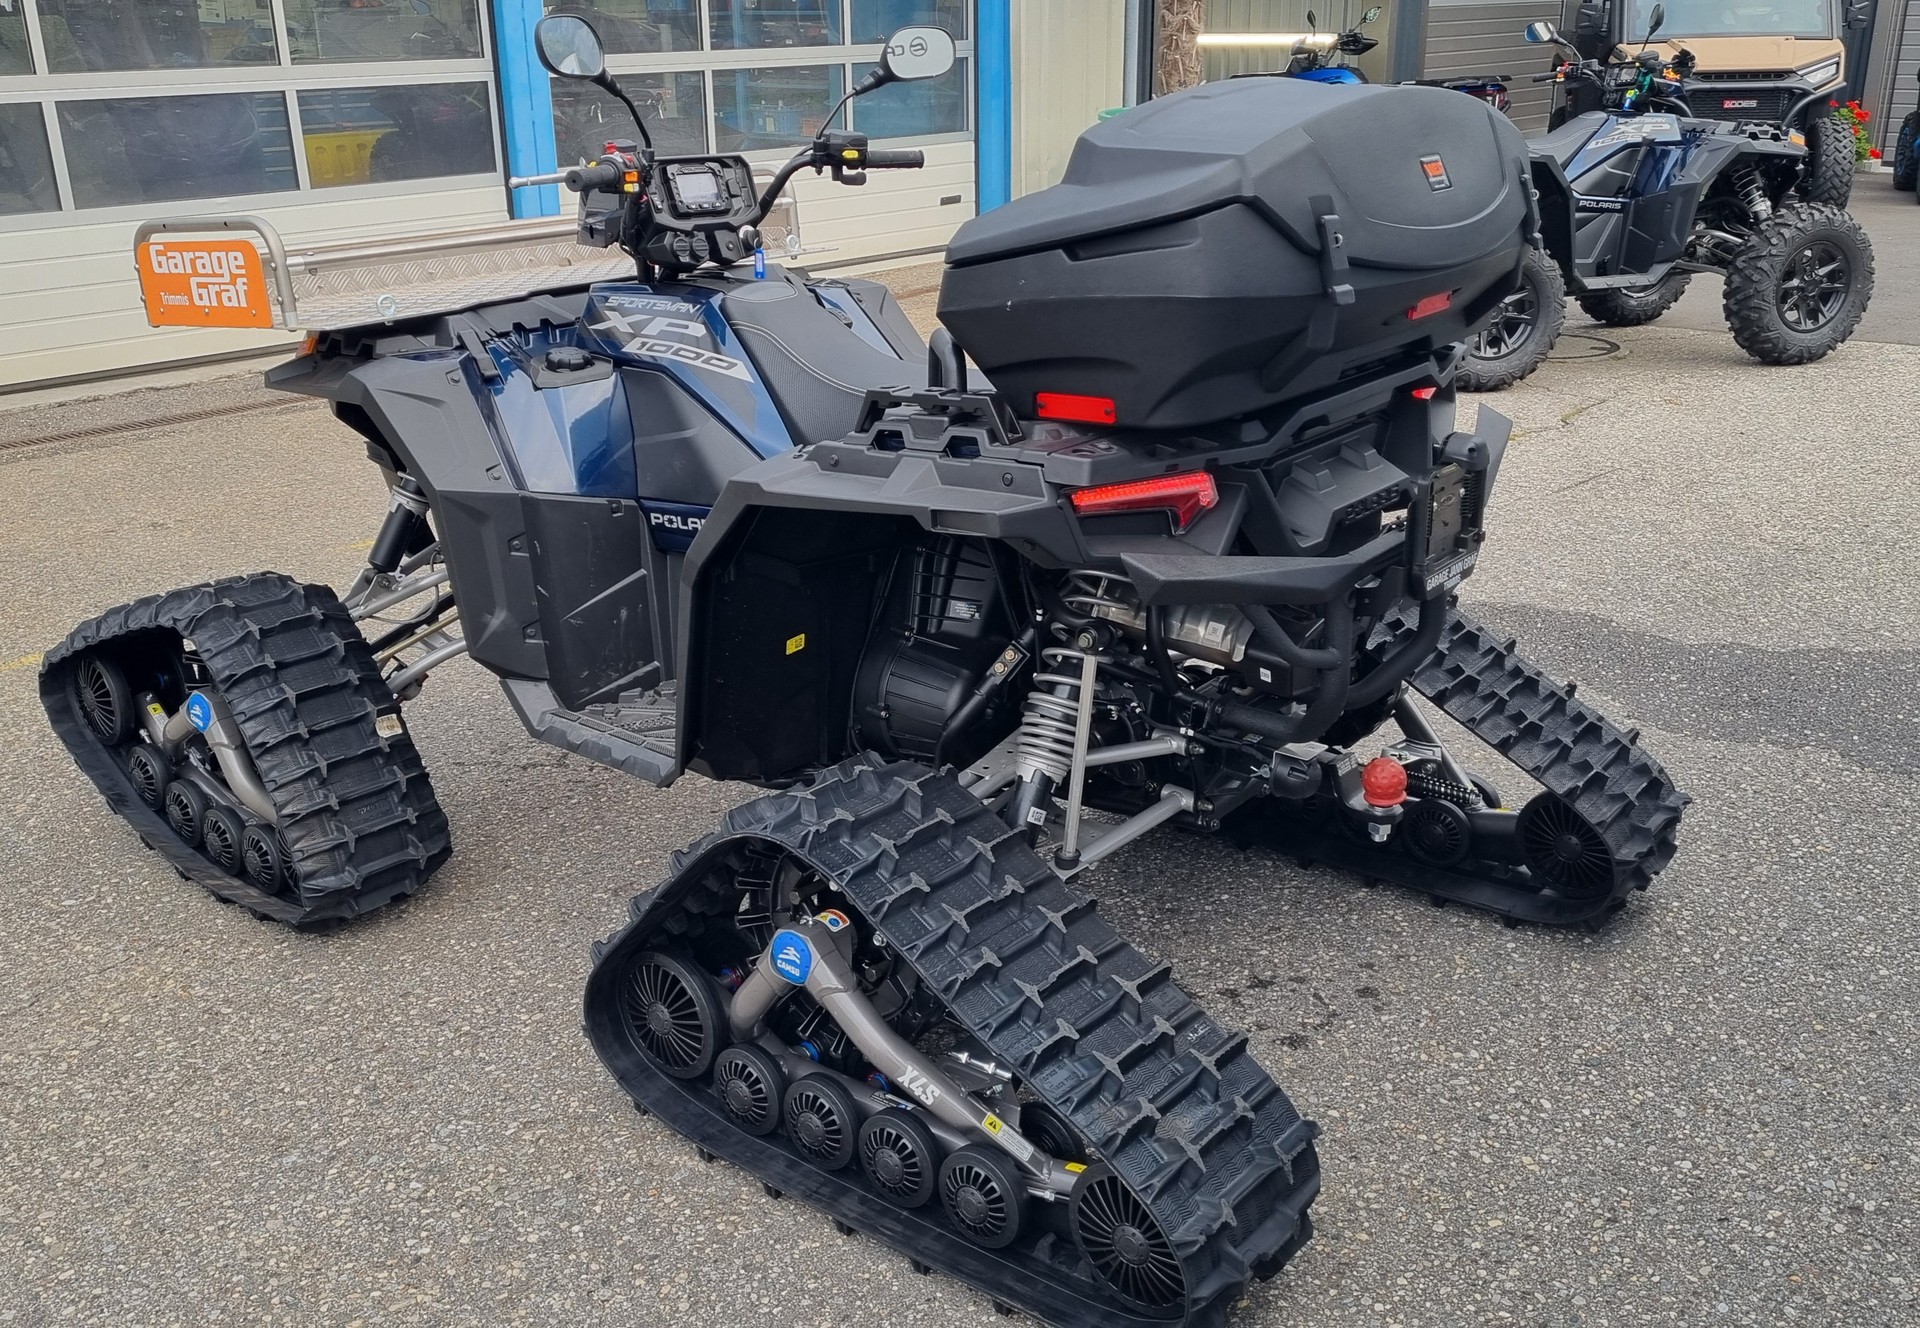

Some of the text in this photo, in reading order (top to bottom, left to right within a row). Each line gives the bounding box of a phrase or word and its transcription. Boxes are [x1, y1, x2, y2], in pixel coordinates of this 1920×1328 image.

[1608, 123, 1671, 136] XP
[1579, 200, 1621, 209] POLARIS
[150, 245, 246, 282] Garage
[160, 277, 248, 307] Trimmis Graf
[605, 296, 700, 314] SPORTSMAN
[588, 310, 706, 337] XP
[635, 339, 738, 371] 1000
[1426, 568, 1450, 591] GARAGE
[777, 959, 800, 976] CAMSO
[897, 1064, 941, 1106] X4S
